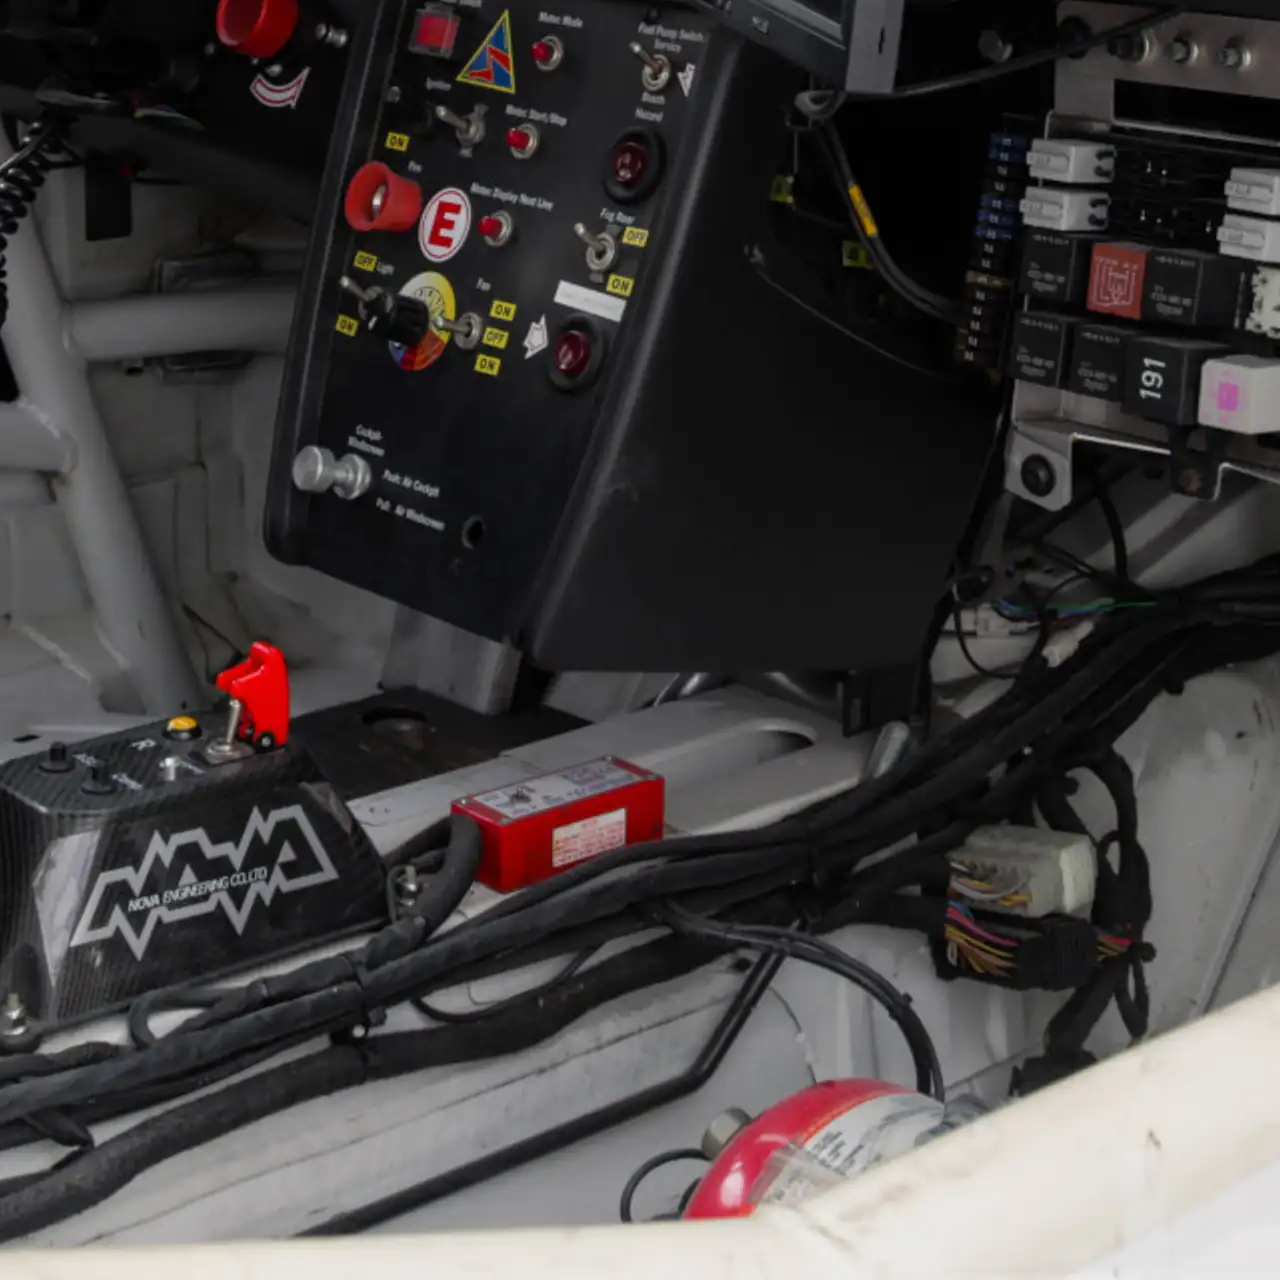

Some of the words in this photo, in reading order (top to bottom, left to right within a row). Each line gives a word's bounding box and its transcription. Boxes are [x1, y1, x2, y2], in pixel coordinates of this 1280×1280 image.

[428, 201, 461, 248] E
[1138, 357, 1167, 401] 191
[163, 876, 229, 905] ENGINEERING
